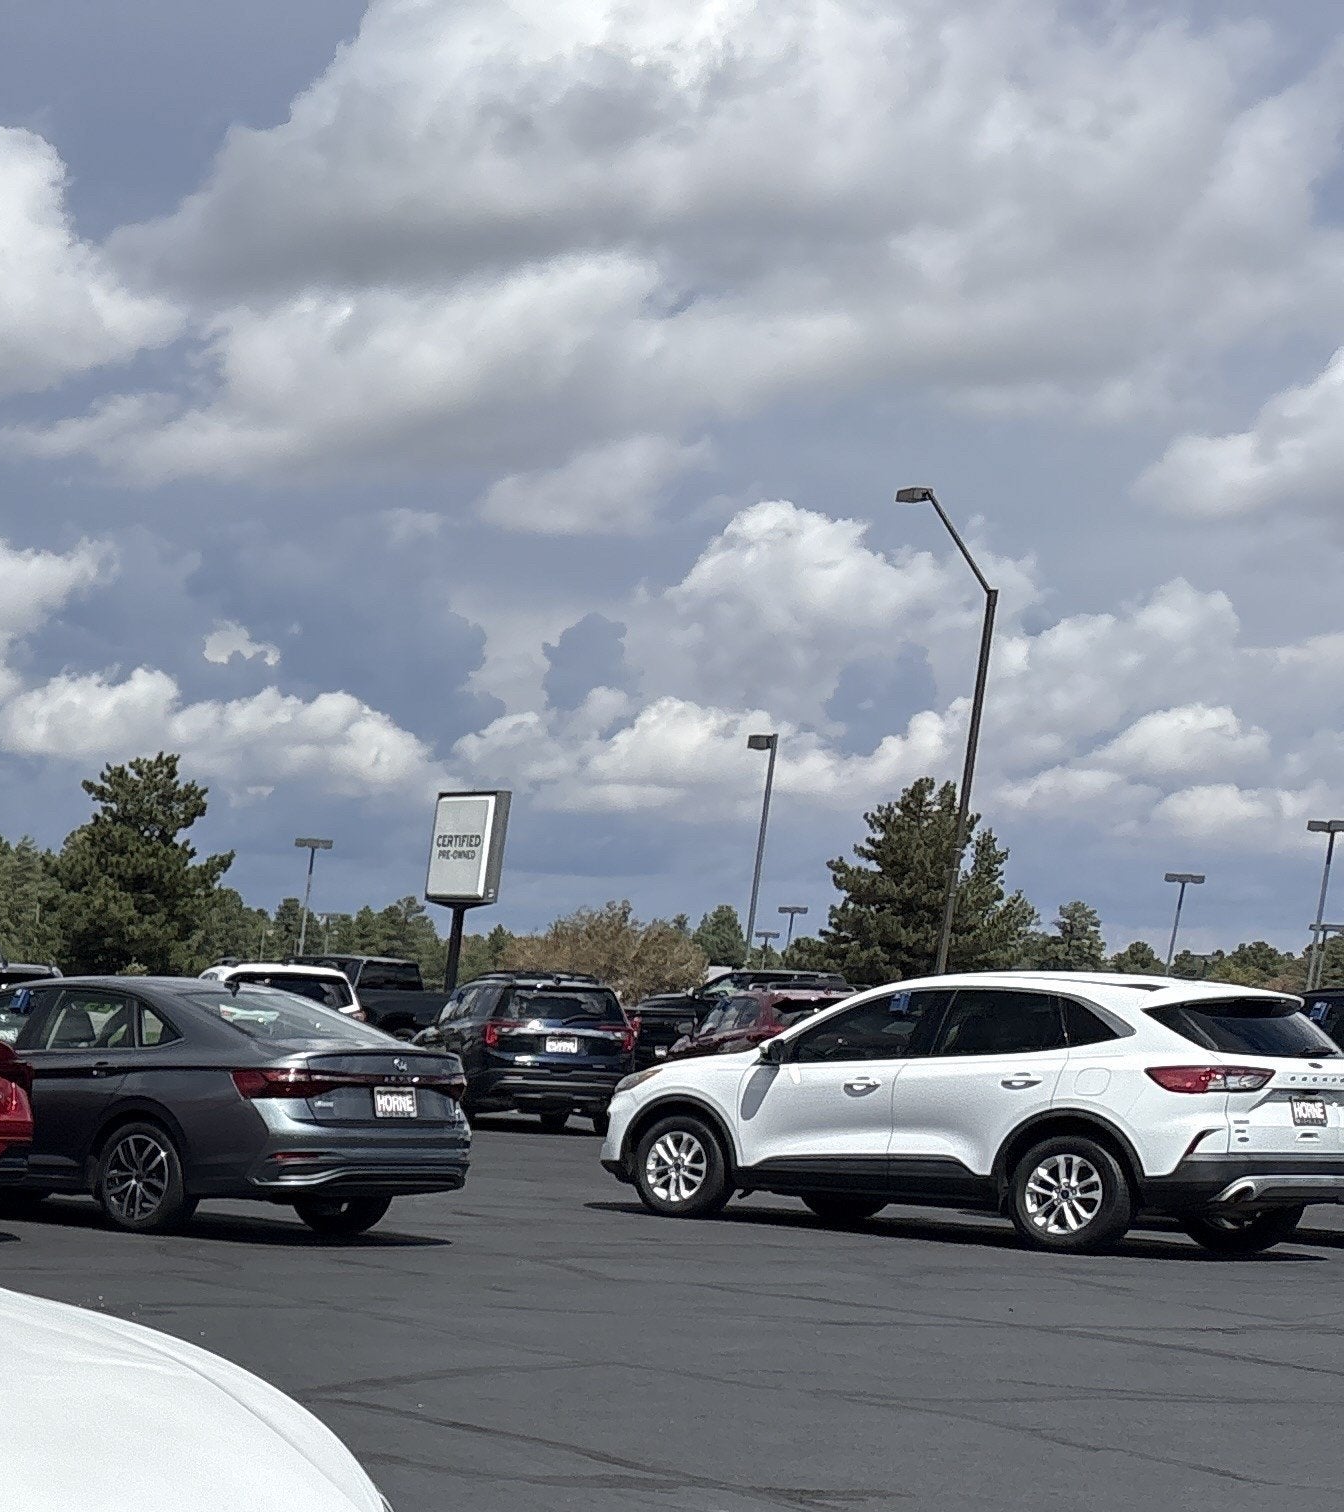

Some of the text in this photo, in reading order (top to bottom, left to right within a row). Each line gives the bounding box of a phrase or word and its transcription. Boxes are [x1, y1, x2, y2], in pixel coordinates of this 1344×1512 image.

[436, 834, 482, 848] CERTIFIED
[437, 849, 476, 860] PRE-OWNED
[376, 1094, 414, 1112] HORNE
[1294, 1101, 1325, 1119] HORNE
